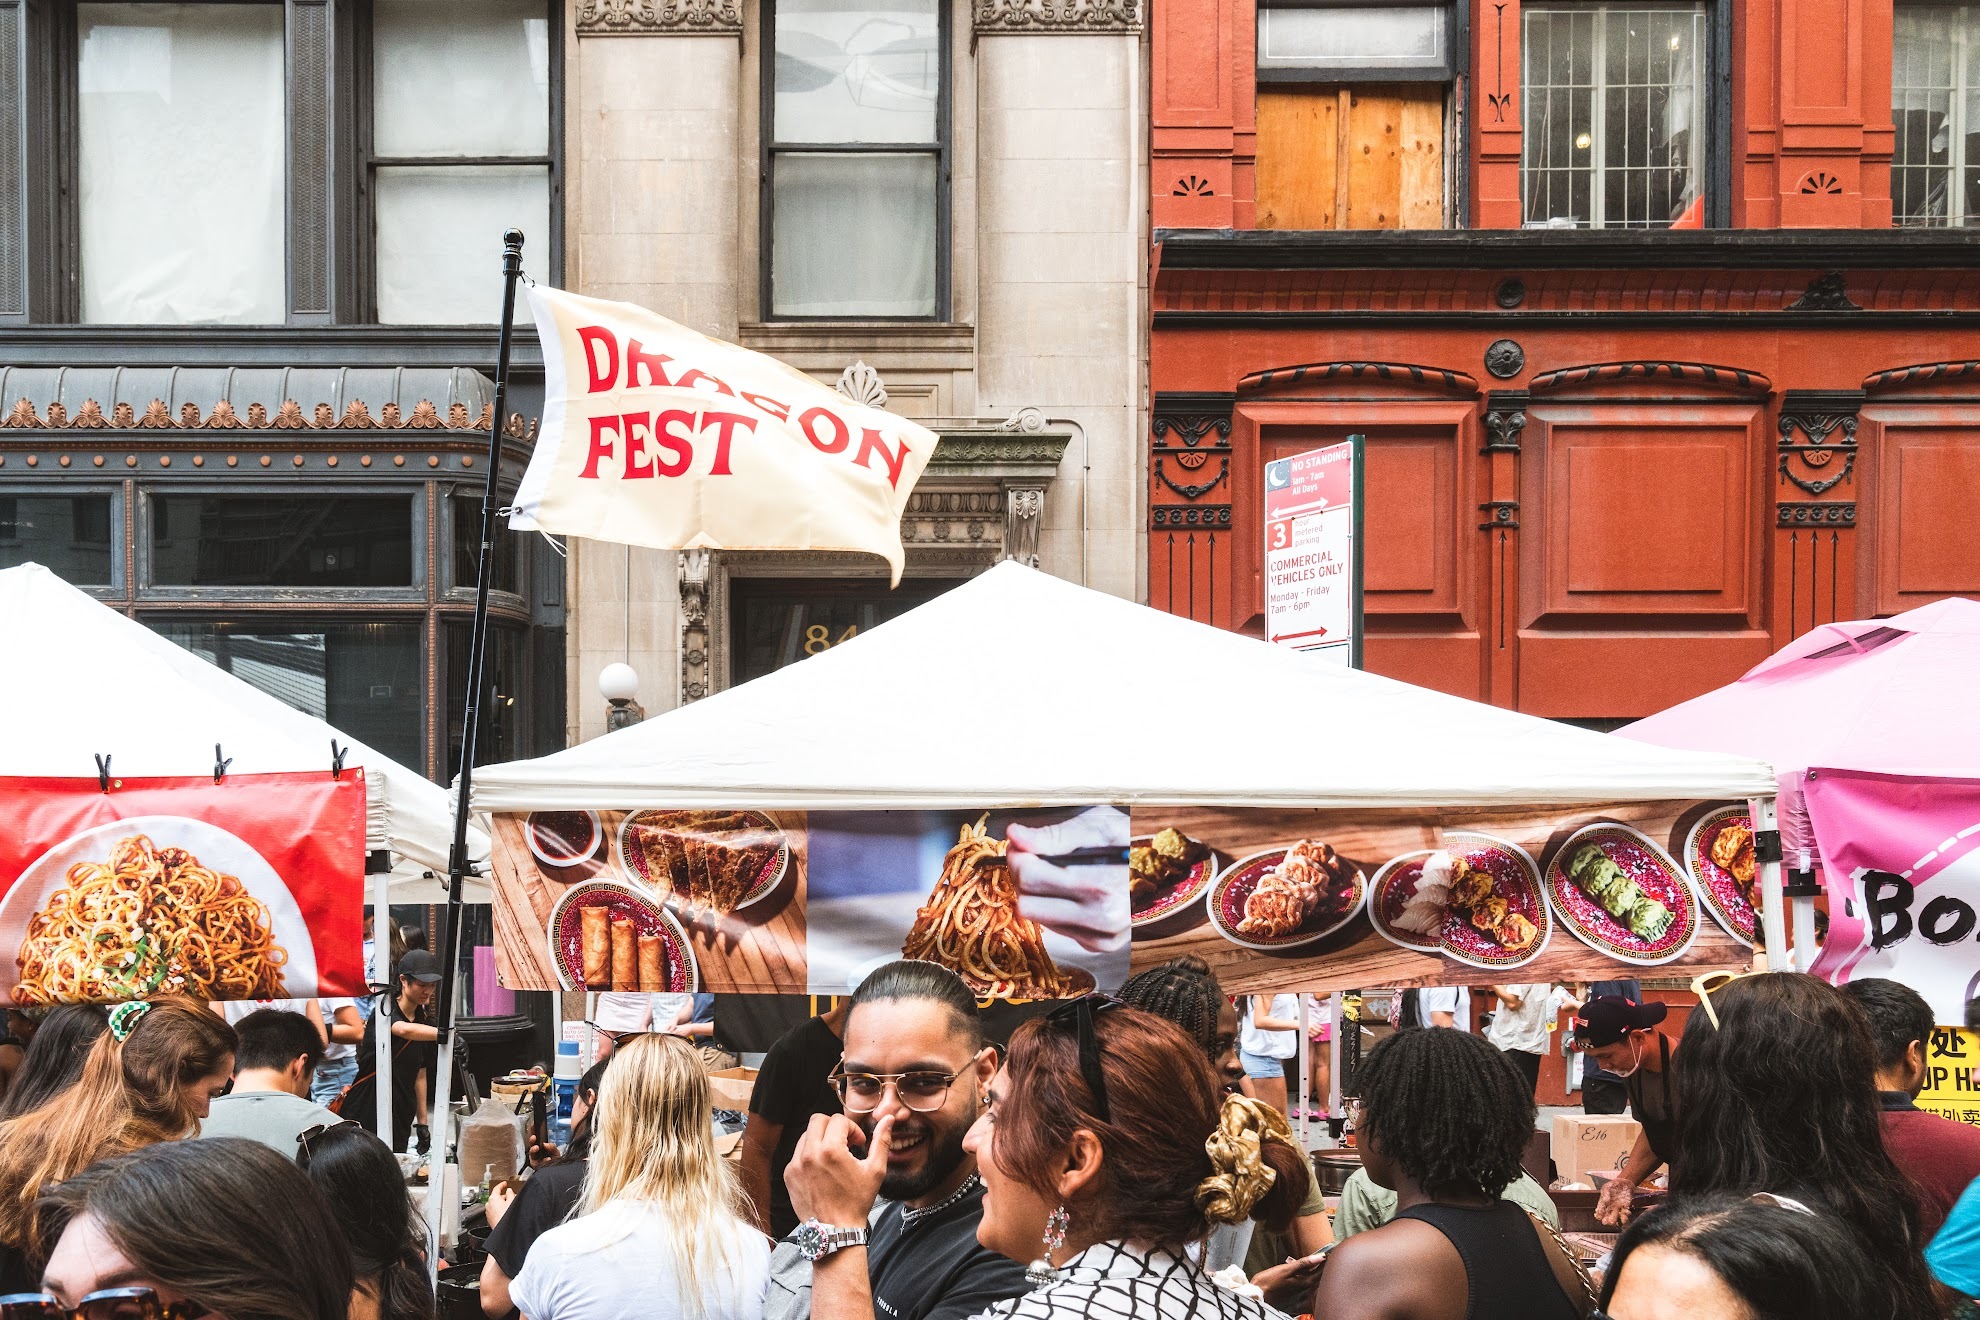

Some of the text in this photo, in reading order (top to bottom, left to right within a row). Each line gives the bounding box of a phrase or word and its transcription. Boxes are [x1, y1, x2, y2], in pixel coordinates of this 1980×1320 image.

[578, 409, 758, 479] FEST
[1292, 450, 1348, 473] NO STANDING
[1310, 472, 1325, 481] 7am
[1292, 483, 1318, 496] All Days
[1272, 523, 1287, 548] 3
[1295, 524, 1323, 537] metered
[1295, 536, 1320, 548] parking
[1270, 550, 1333, 573] COMMERCIAL
[1270, 562, 1344, 586] VEHICLES ONLY
[1270, 592, 1299, 603] Monday
[1306, 586, 1331, 597] Friday
[1270, 605, 1287, 615] 7am
[1293, 601, 1311, 611] 6pm
[1860, 869, 1980, 953] Bo
[1930, 1028, 1967, 1059] 处
[1581, 1126, 1607, 1141] E16
